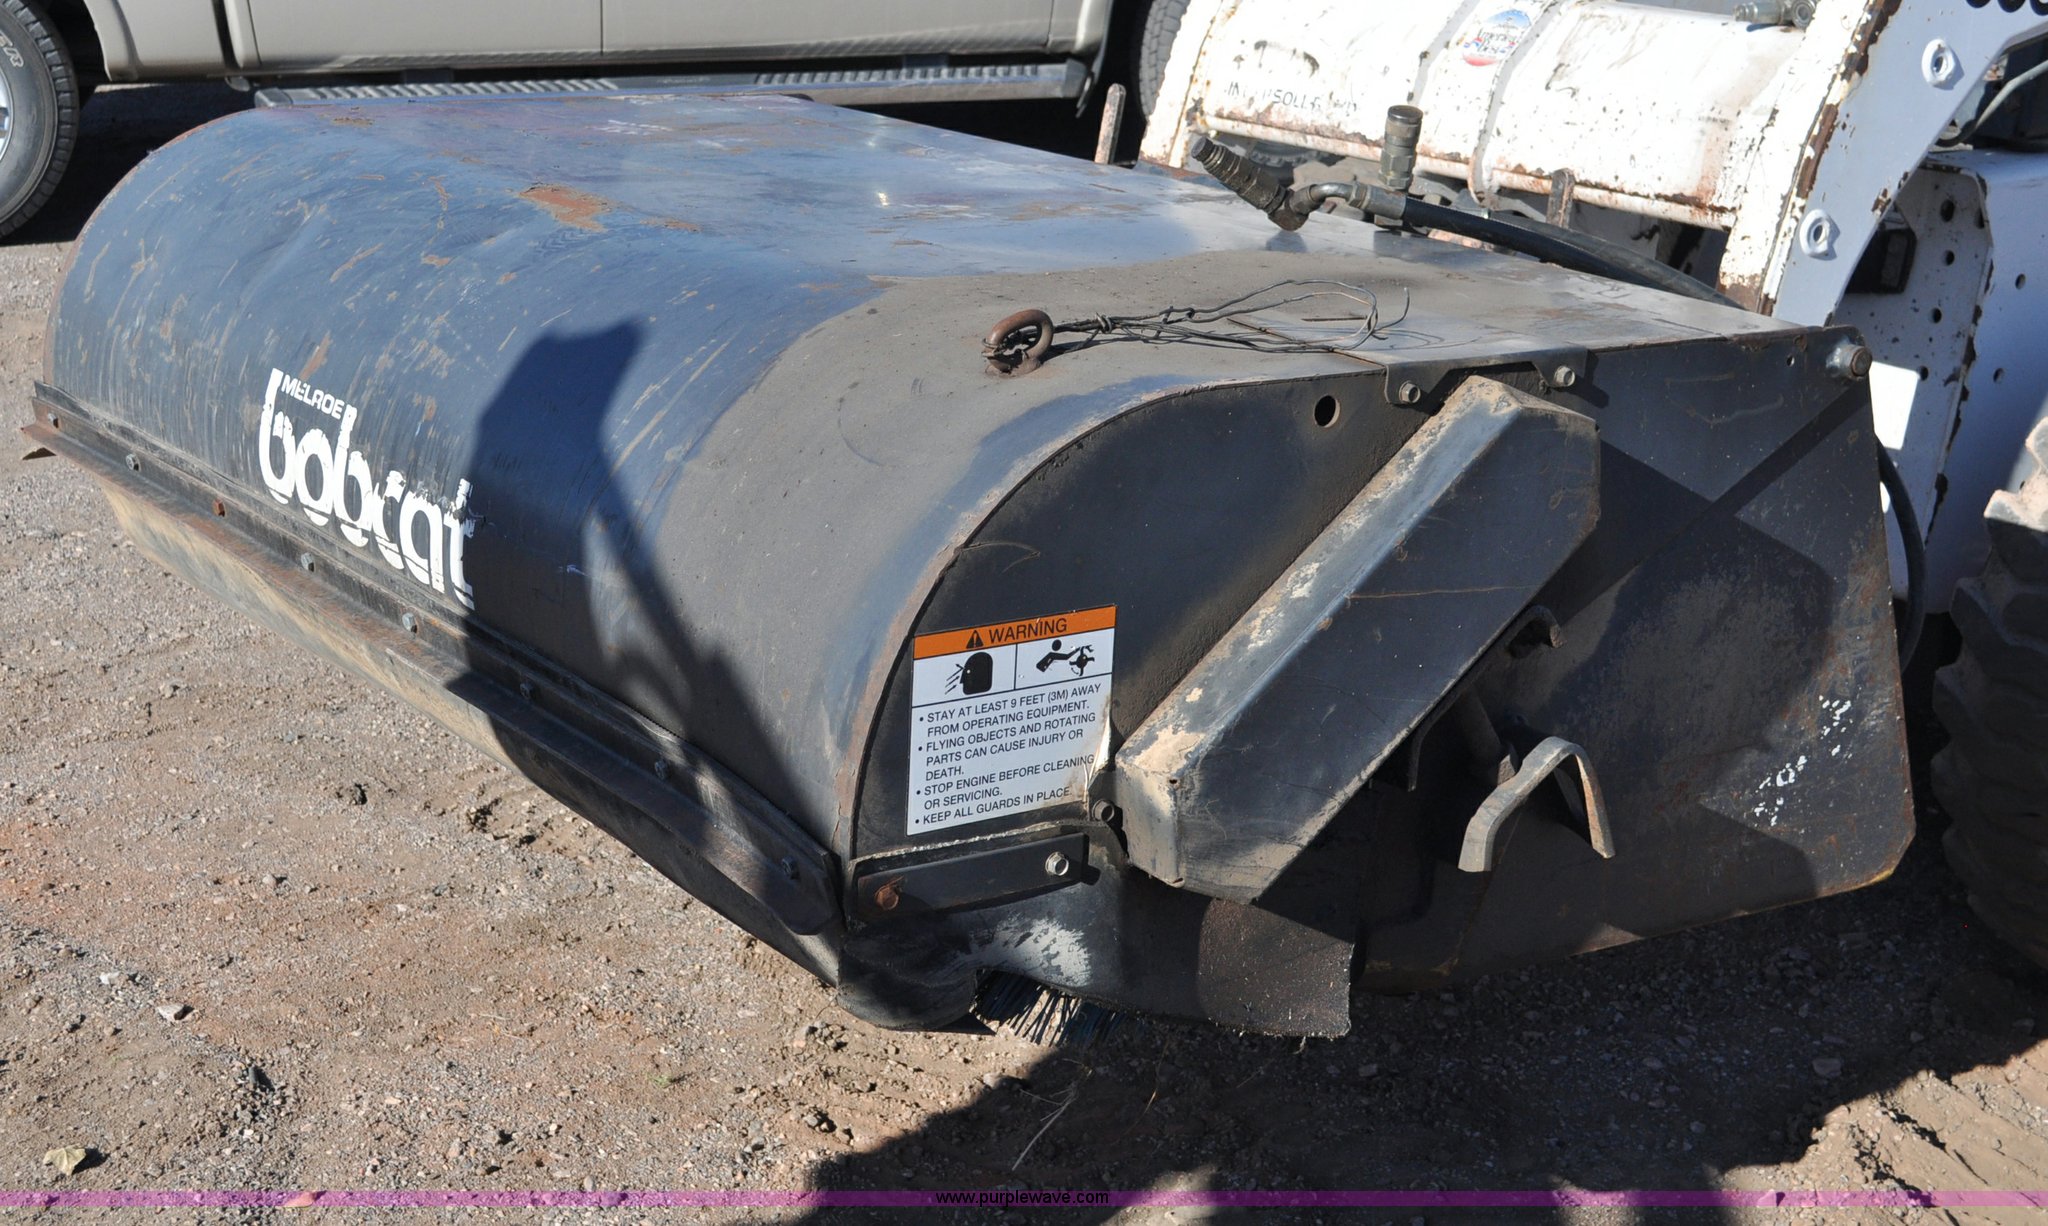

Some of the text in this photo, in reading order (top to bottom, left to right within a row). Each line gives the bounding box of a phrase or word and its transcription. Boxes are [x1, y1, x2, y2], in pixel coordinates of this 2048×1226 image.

[281, 374, 345, 421] MELROE
[259, 367, 476, 611] bobcat
[989, 618, 1067, 644] WARNING
[927, 683, 1102, 723] STAY AT LEAST 9 FEET (3M) AWAY
[927, 699, 1089, 737] FROM OPERATING EQUIPMENT.
[926, 712, 1096, 752] FLYING OBJECTS AND ROTATING
[926, 728, 1083, 767] PARTS CAN CAUSE INJURY OR
[924, 755, 1094, 796] STOP ENGINE BEFORE CLEANING
[926, 766, 964, 782] DEATH.
[923, 787, 1072, 825] KEEP ALL GUARDS IN PLACE.
[924, 787, 1003, 810] OR SERVICING.
